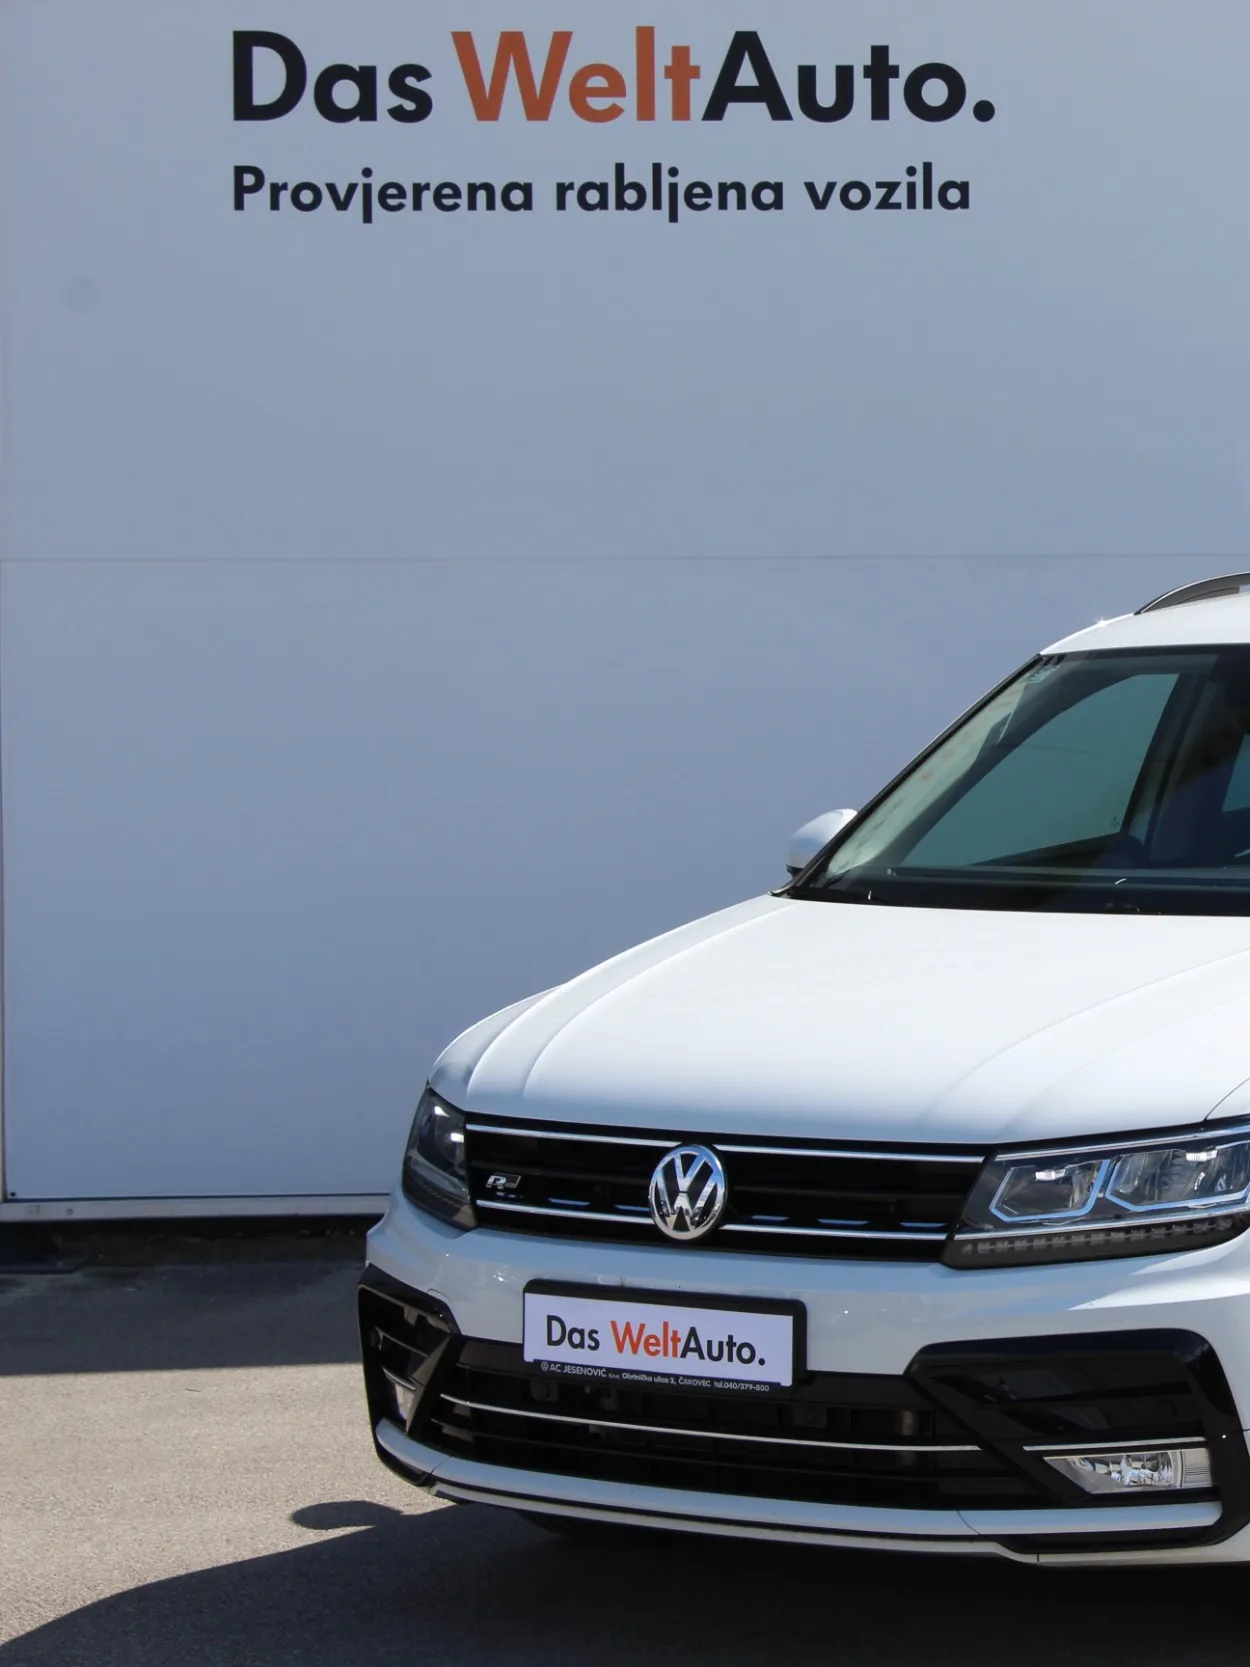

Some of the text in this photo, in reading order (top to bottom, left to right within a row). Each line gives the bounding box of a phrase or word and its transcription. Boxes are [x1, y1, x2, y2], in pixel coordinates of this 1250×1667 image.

[233, 26, 996, 123] Das WeltAuto.
[233, 161, 970, 224] Provjerena rabljena vozila
[546, 1315, 766, 1366] Das WeltAuto.
[549, 1363, 561, 1373] AC
